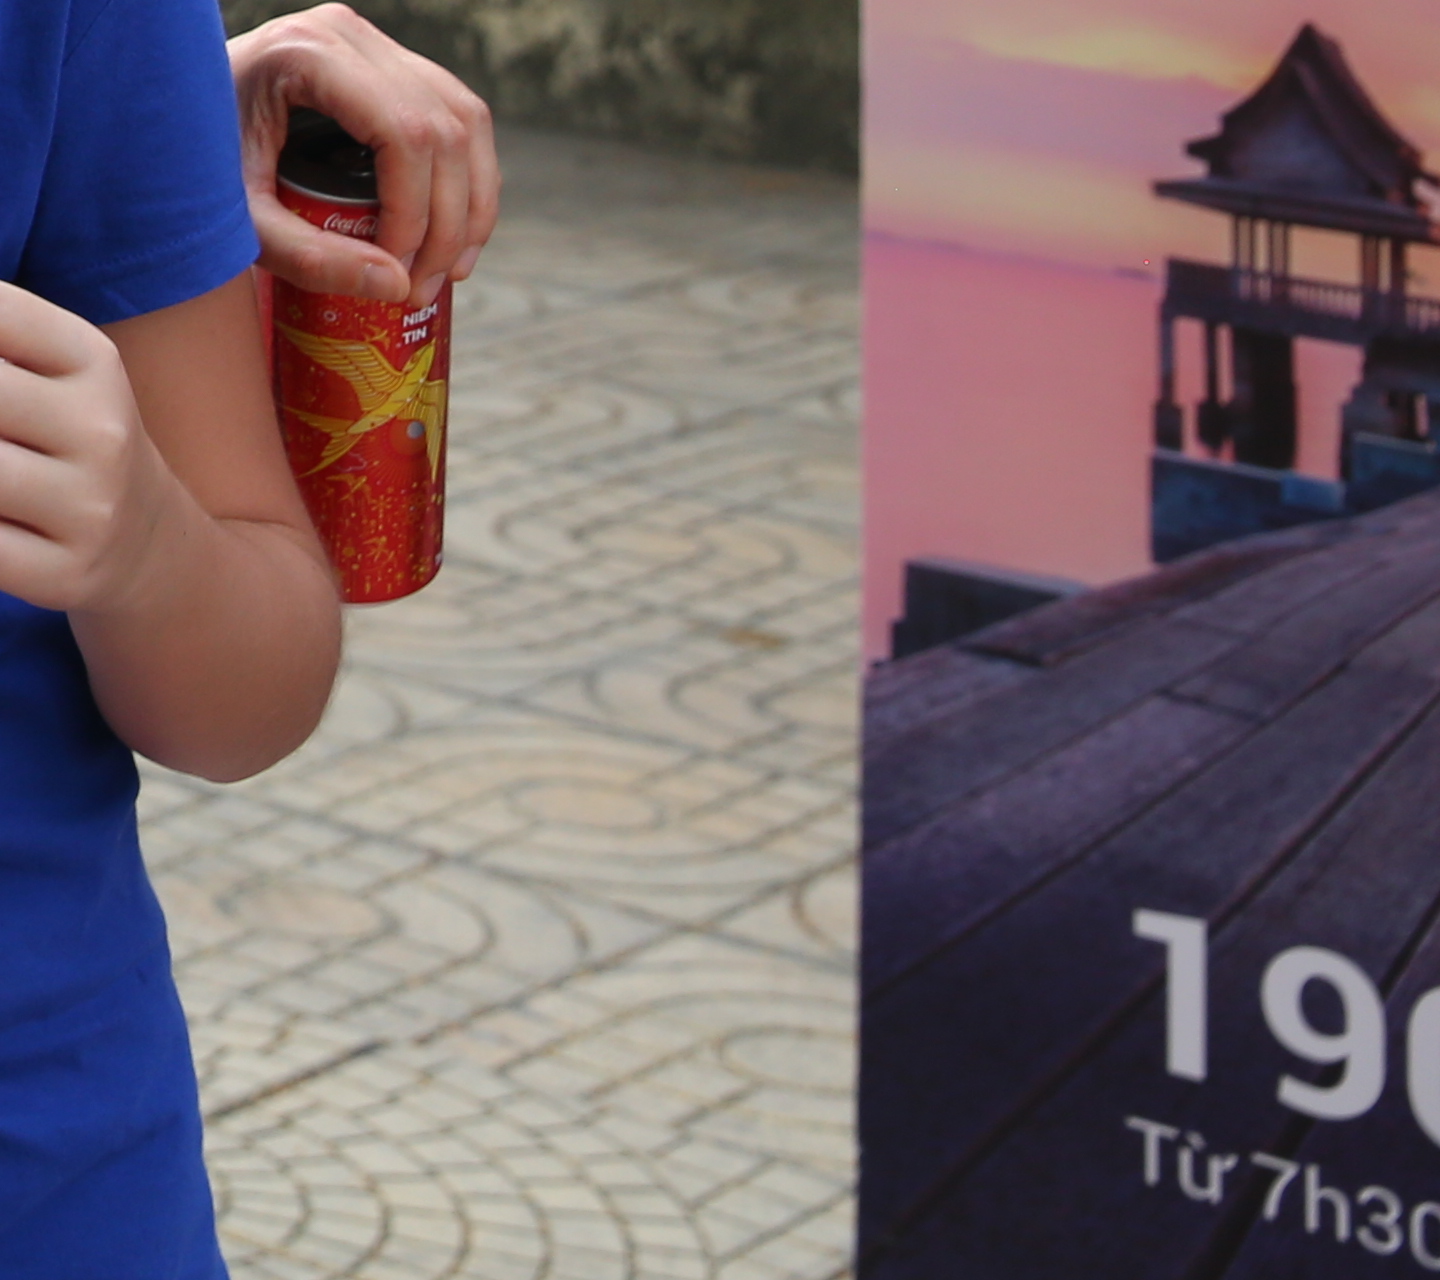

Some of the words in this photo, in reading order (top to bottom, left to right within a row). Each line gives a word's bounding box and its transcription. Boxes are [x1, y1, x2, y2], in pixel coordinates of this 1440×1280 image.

[402, 326, 427, 345] TIN
[1132, 907, 1440, 1148] 19
[1125, 1115, 1238, 1205] Từ
